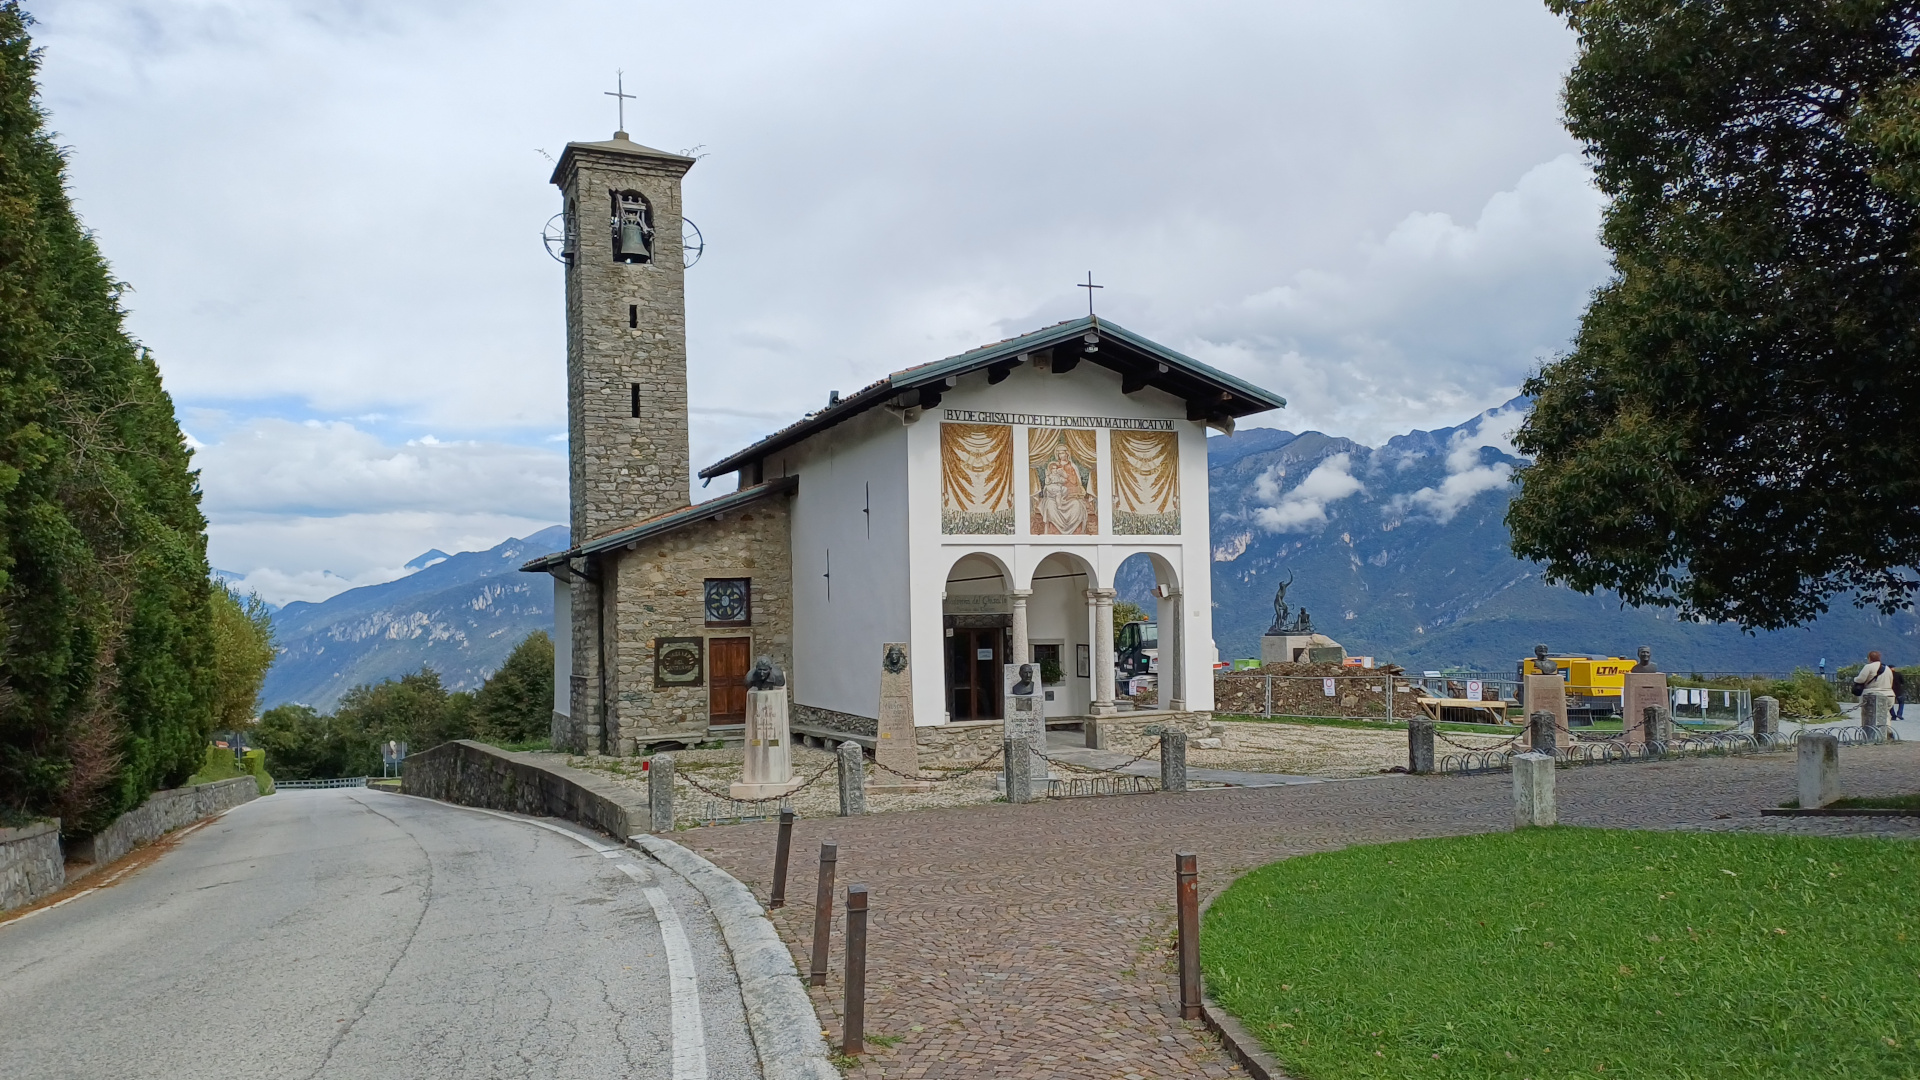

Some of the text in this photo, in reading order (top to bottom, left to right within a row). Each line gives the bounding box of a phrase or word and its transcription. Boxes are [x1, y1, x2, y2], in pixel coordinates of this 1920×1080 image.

[964, 410, 976, 421] DE
[978, 411, 1025, 424] GHISALLO
[1596, 666, 1618, 675] LTM
